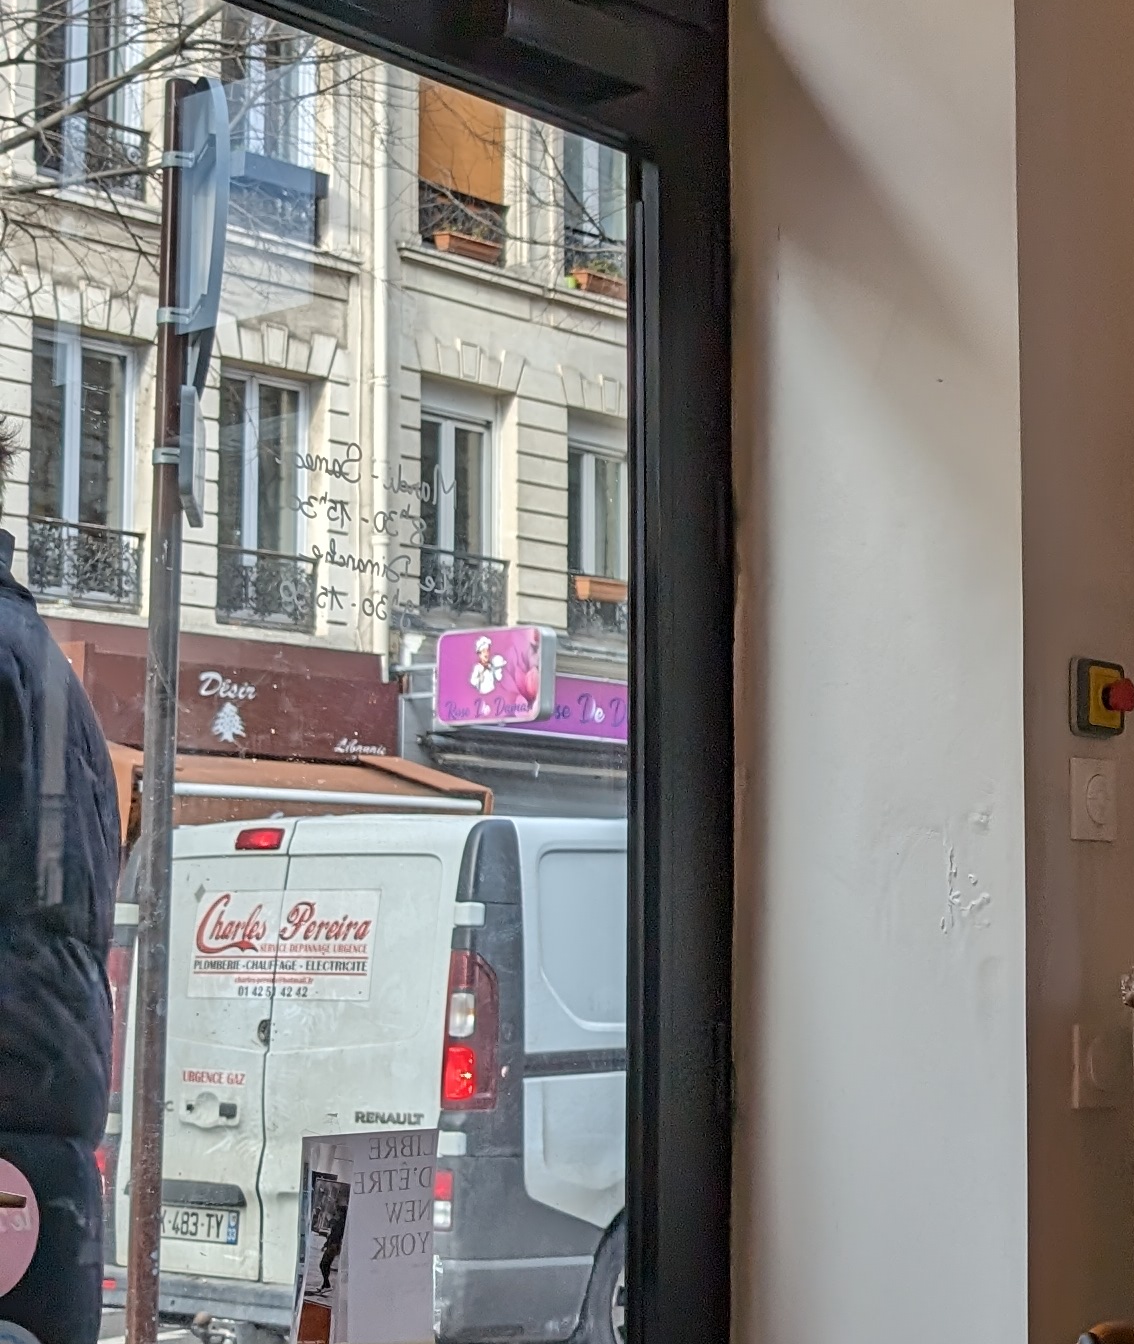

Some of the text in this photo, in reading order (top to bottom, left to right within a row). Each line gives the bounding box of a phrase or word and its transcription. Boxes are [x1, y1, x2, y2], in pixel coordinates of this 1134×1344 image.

[445, 701, 471, 721] Rose
[578, 692, 606, 725] De
[196, 892, 373, 954] Charles Pereira
[193, 959, 241, 971] PLOMBERIE
[305, 960, 368, 973] ELECTRICITE
[238, 985, 249, 997] 01
[252, 986, 263, 998] 42
[280, 986, 293, 998] 42
[295, 986, 308, 998] 42
[182, 1070, 246, 1086] URGENCE GAZ
[354, 1110, 425, 1125] RENAULT
[161, 1209, 224, 1239] -483-TY
